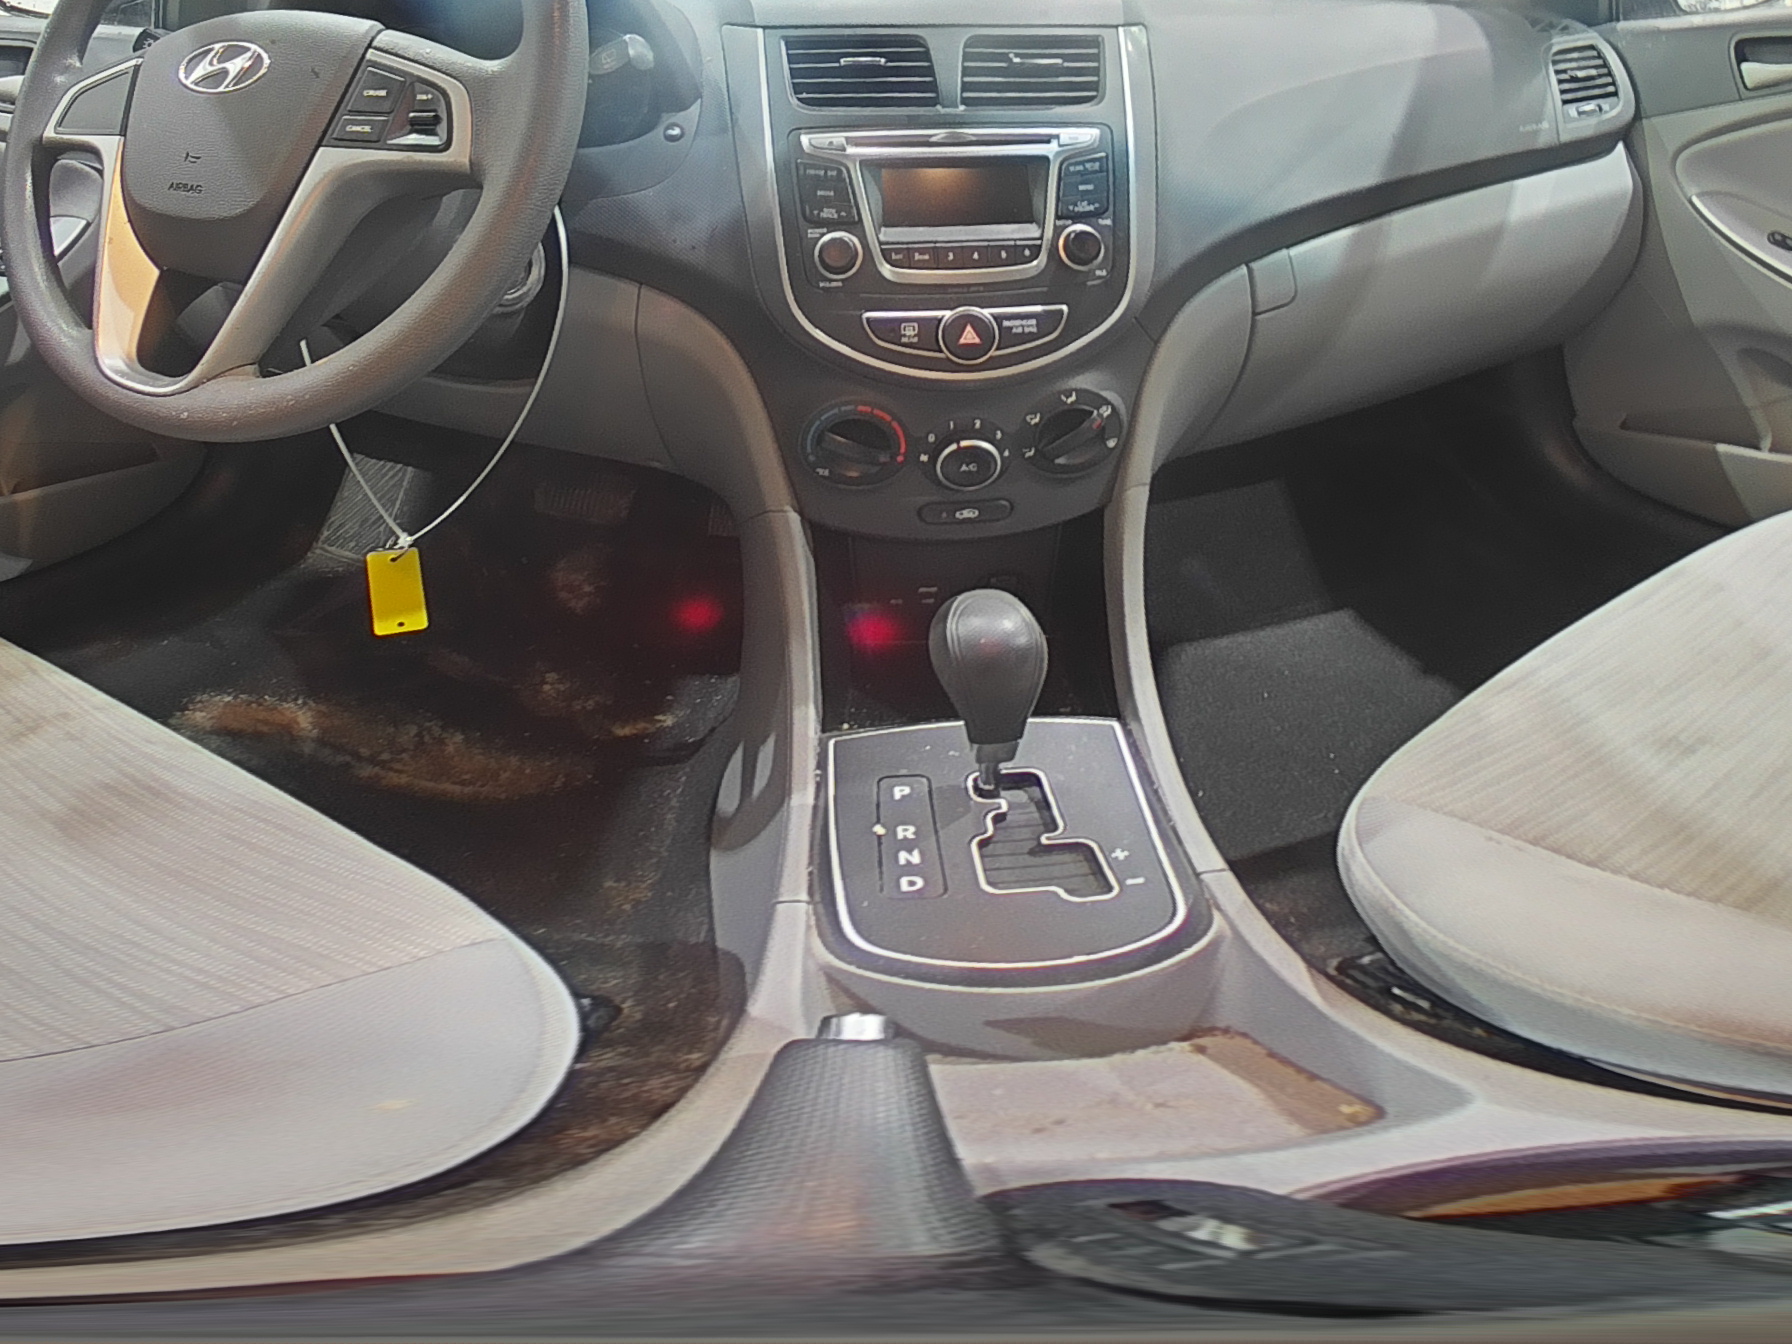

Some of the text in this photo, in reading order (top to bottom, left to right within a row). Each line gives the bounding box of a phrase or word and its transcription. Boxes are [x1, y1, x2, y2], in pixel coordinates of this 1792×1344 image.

[167, 181, 204, 194] AIRBAG
[947, 251, 955, 260] 3
[972, 251, 979, 260] 4
[893, 785, 912, 801] P
[896, 824, 917, 840] R
[898, 849, 921, 865] N
[899, 875, 925, 892] D
